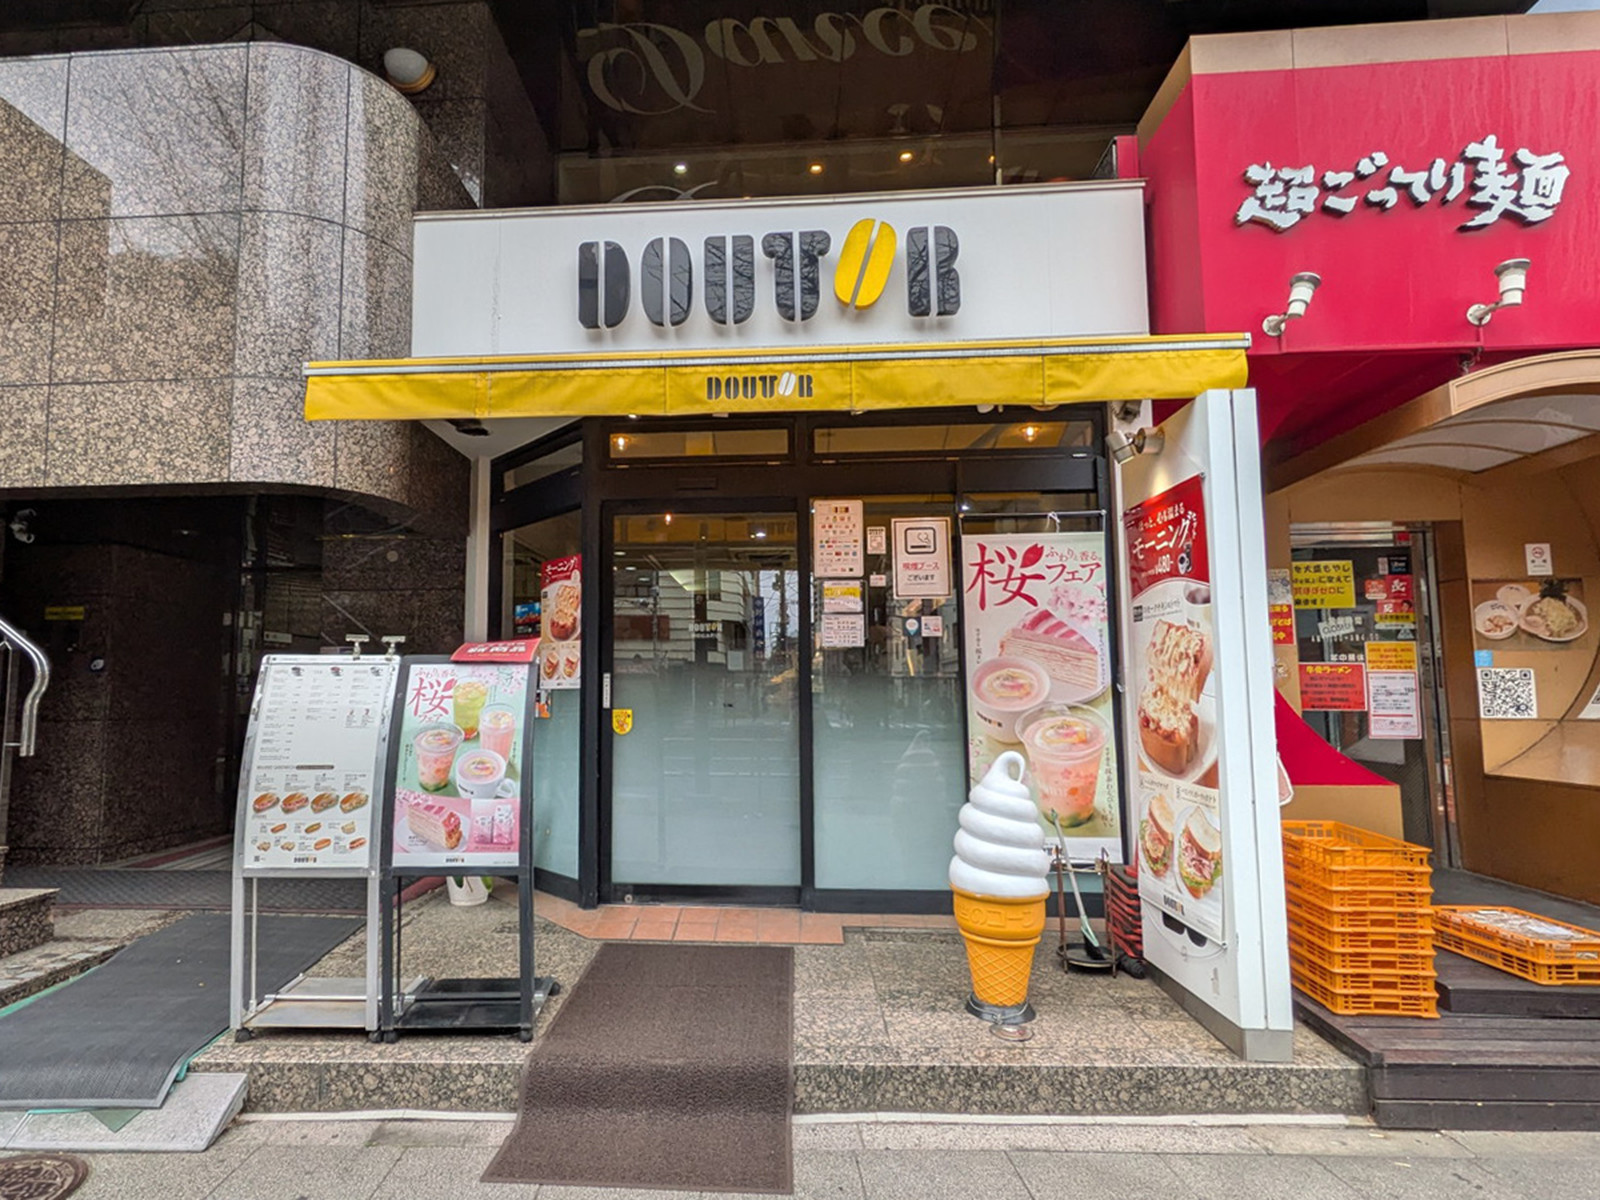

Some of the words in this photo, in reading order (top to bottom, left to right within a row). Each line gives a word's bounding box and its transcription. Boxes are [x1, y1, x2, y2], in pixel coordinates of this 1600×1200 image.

[1236, 134, 1570, 232] 超ごってり麺
[578, 218, 961, 329] DOUTOR
[707, 371, 813, 400] DOUTOR
[966, 542, 1046, 611] 桜
[1045, 562, 1102, 584] フェア
[407, 677, 458, 717] 桜
